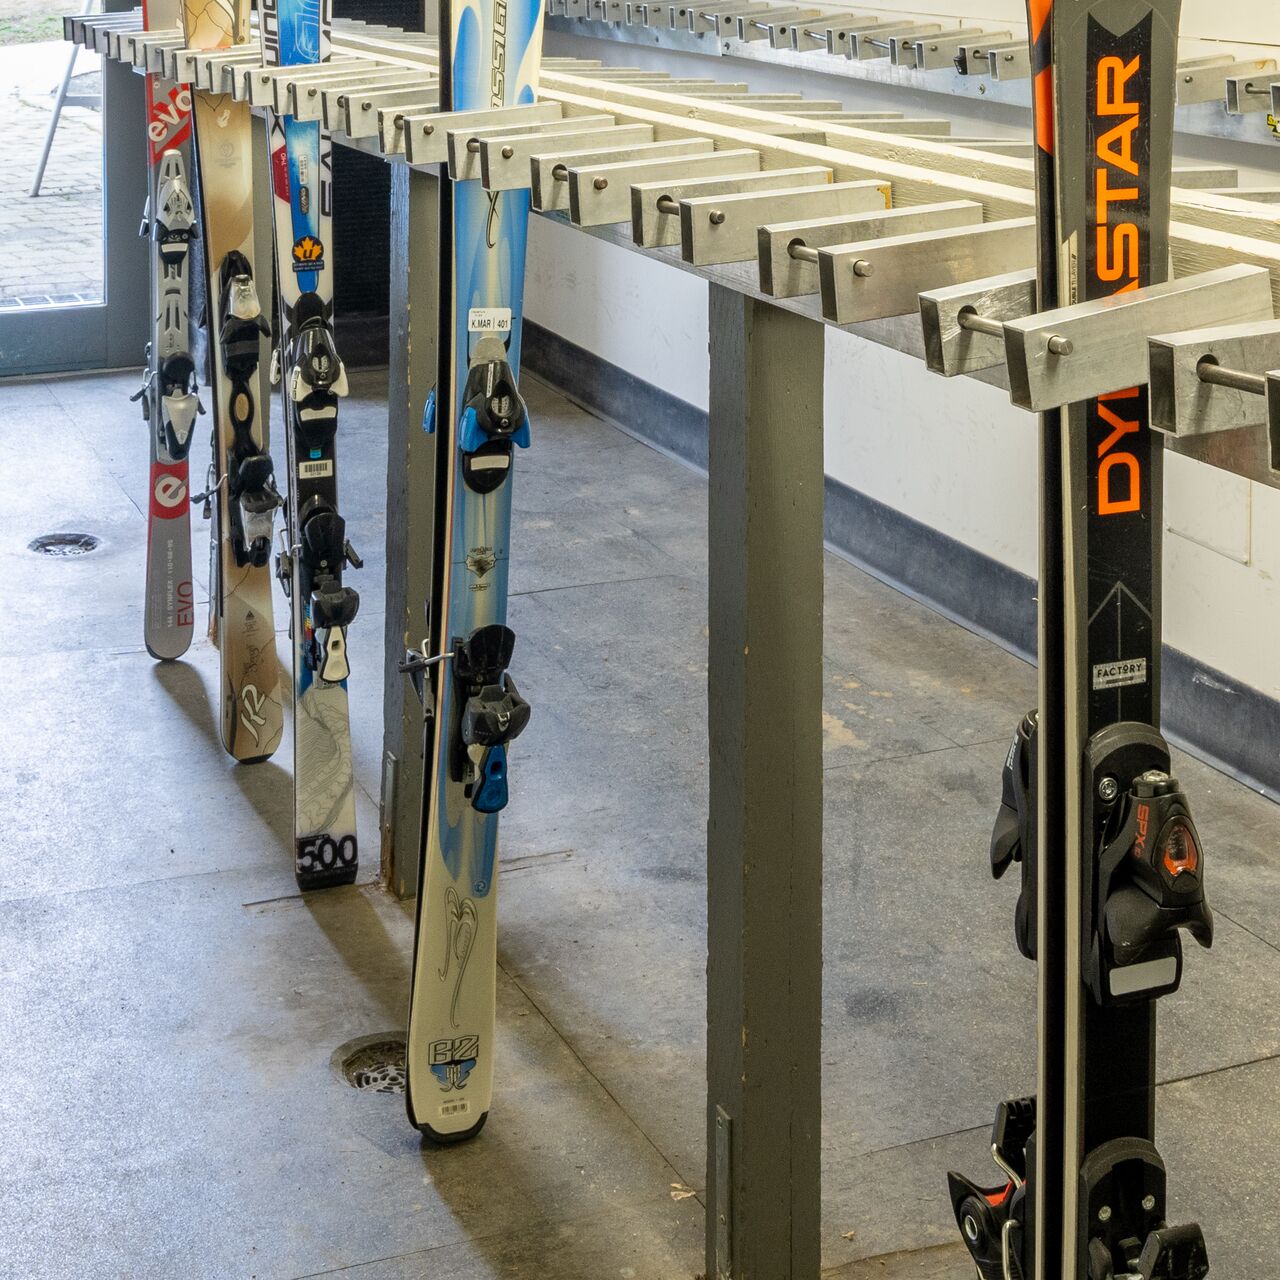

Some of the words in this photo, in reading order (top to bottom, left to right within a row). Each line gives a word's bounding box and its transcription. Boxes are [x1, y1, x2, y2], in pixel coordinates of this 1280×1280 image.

[148, 90, 192, 142] evo
[1096, 55, 1141, 515] DYSTAR
[1097, 663, 1142, 678] FACTORY
[240, 684, 267, 748] K2
[1136, 803, 1149, 849] SPX
